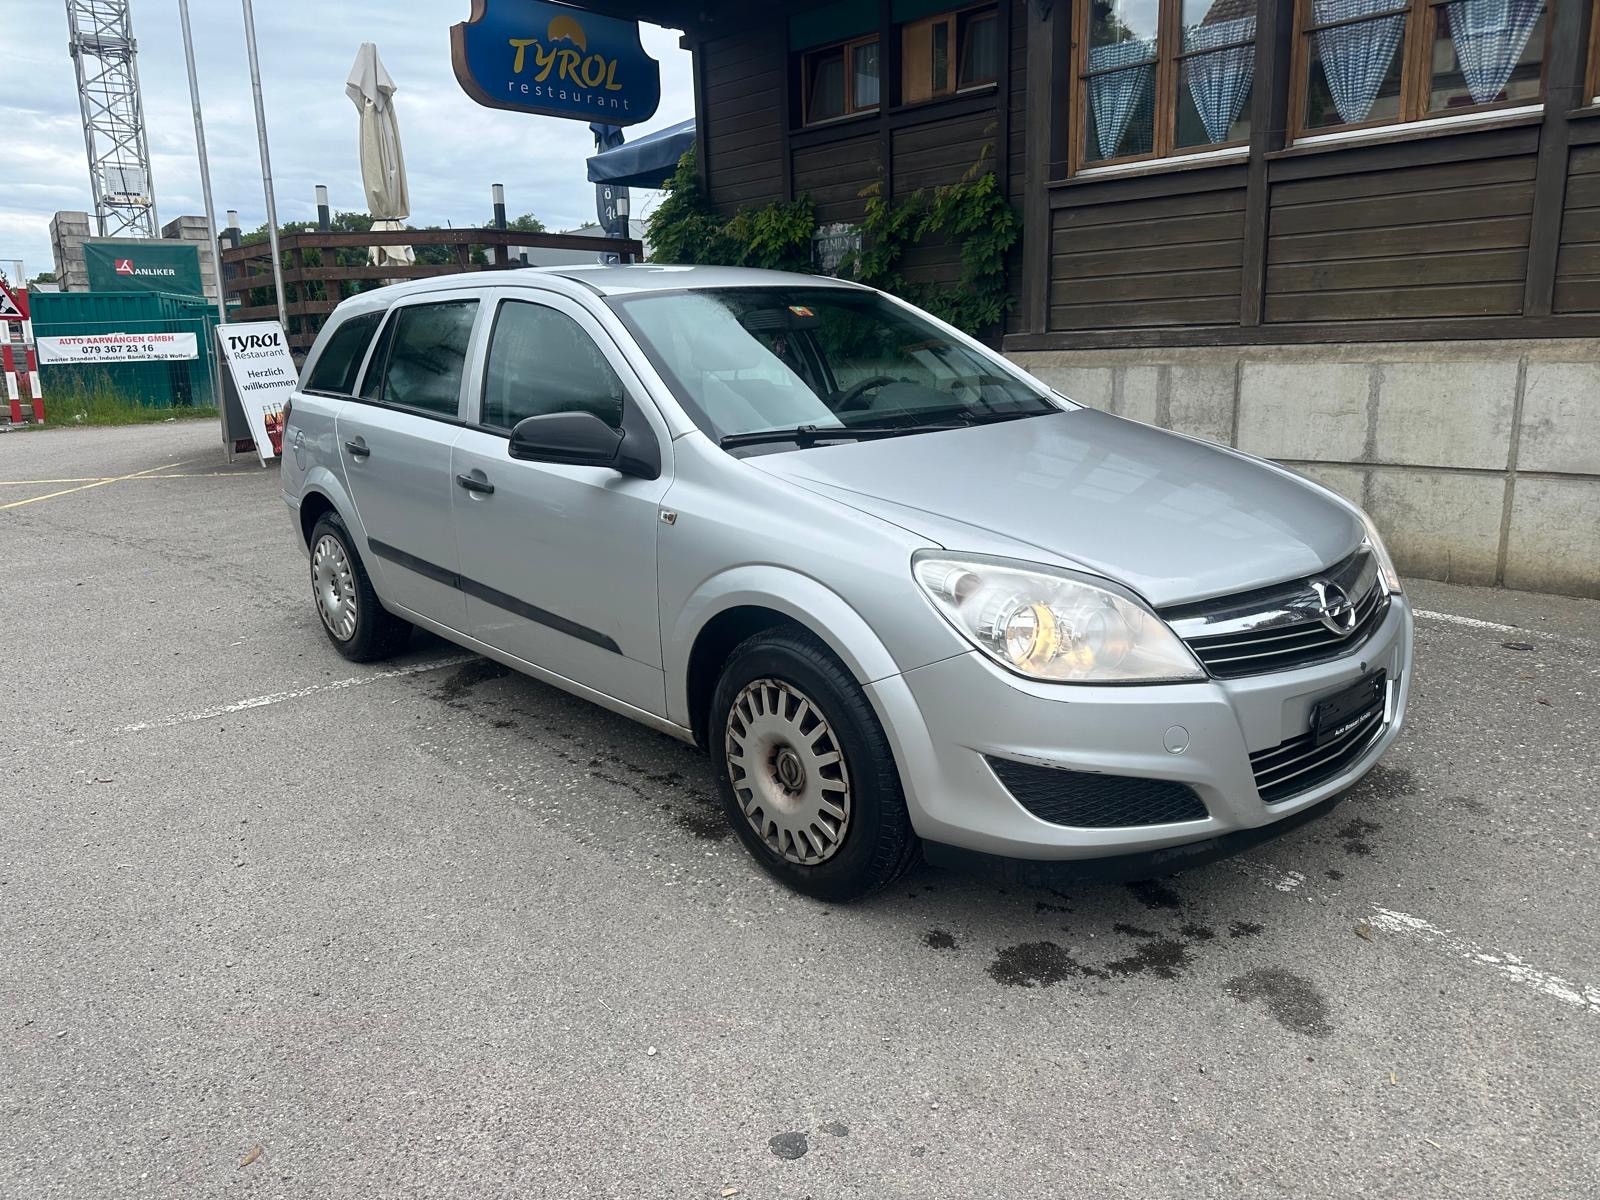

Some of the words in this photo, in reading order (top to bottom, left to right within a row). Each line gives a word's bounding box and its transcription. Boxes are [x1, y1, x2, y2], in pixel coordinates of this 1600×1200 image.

[508, 38, 623, 90] TYROL
[508, 80, 630, 110] restaurant
[134, 268, 176, 276] ANLIKER
[59, 337, 84, 345] AUTO
[228, 333, 281, 353] TYROL
[81, 346, 101, 354] 079
[104, 345, 123, 353] 367
[126, 344, 138, 353] 23
[141, 344, 154, 352] 16
[234, 349, 285, 359] Restaurant
[247, 367, 285, 378] Herzlich
[242, 379, 297, 391] willkommen
